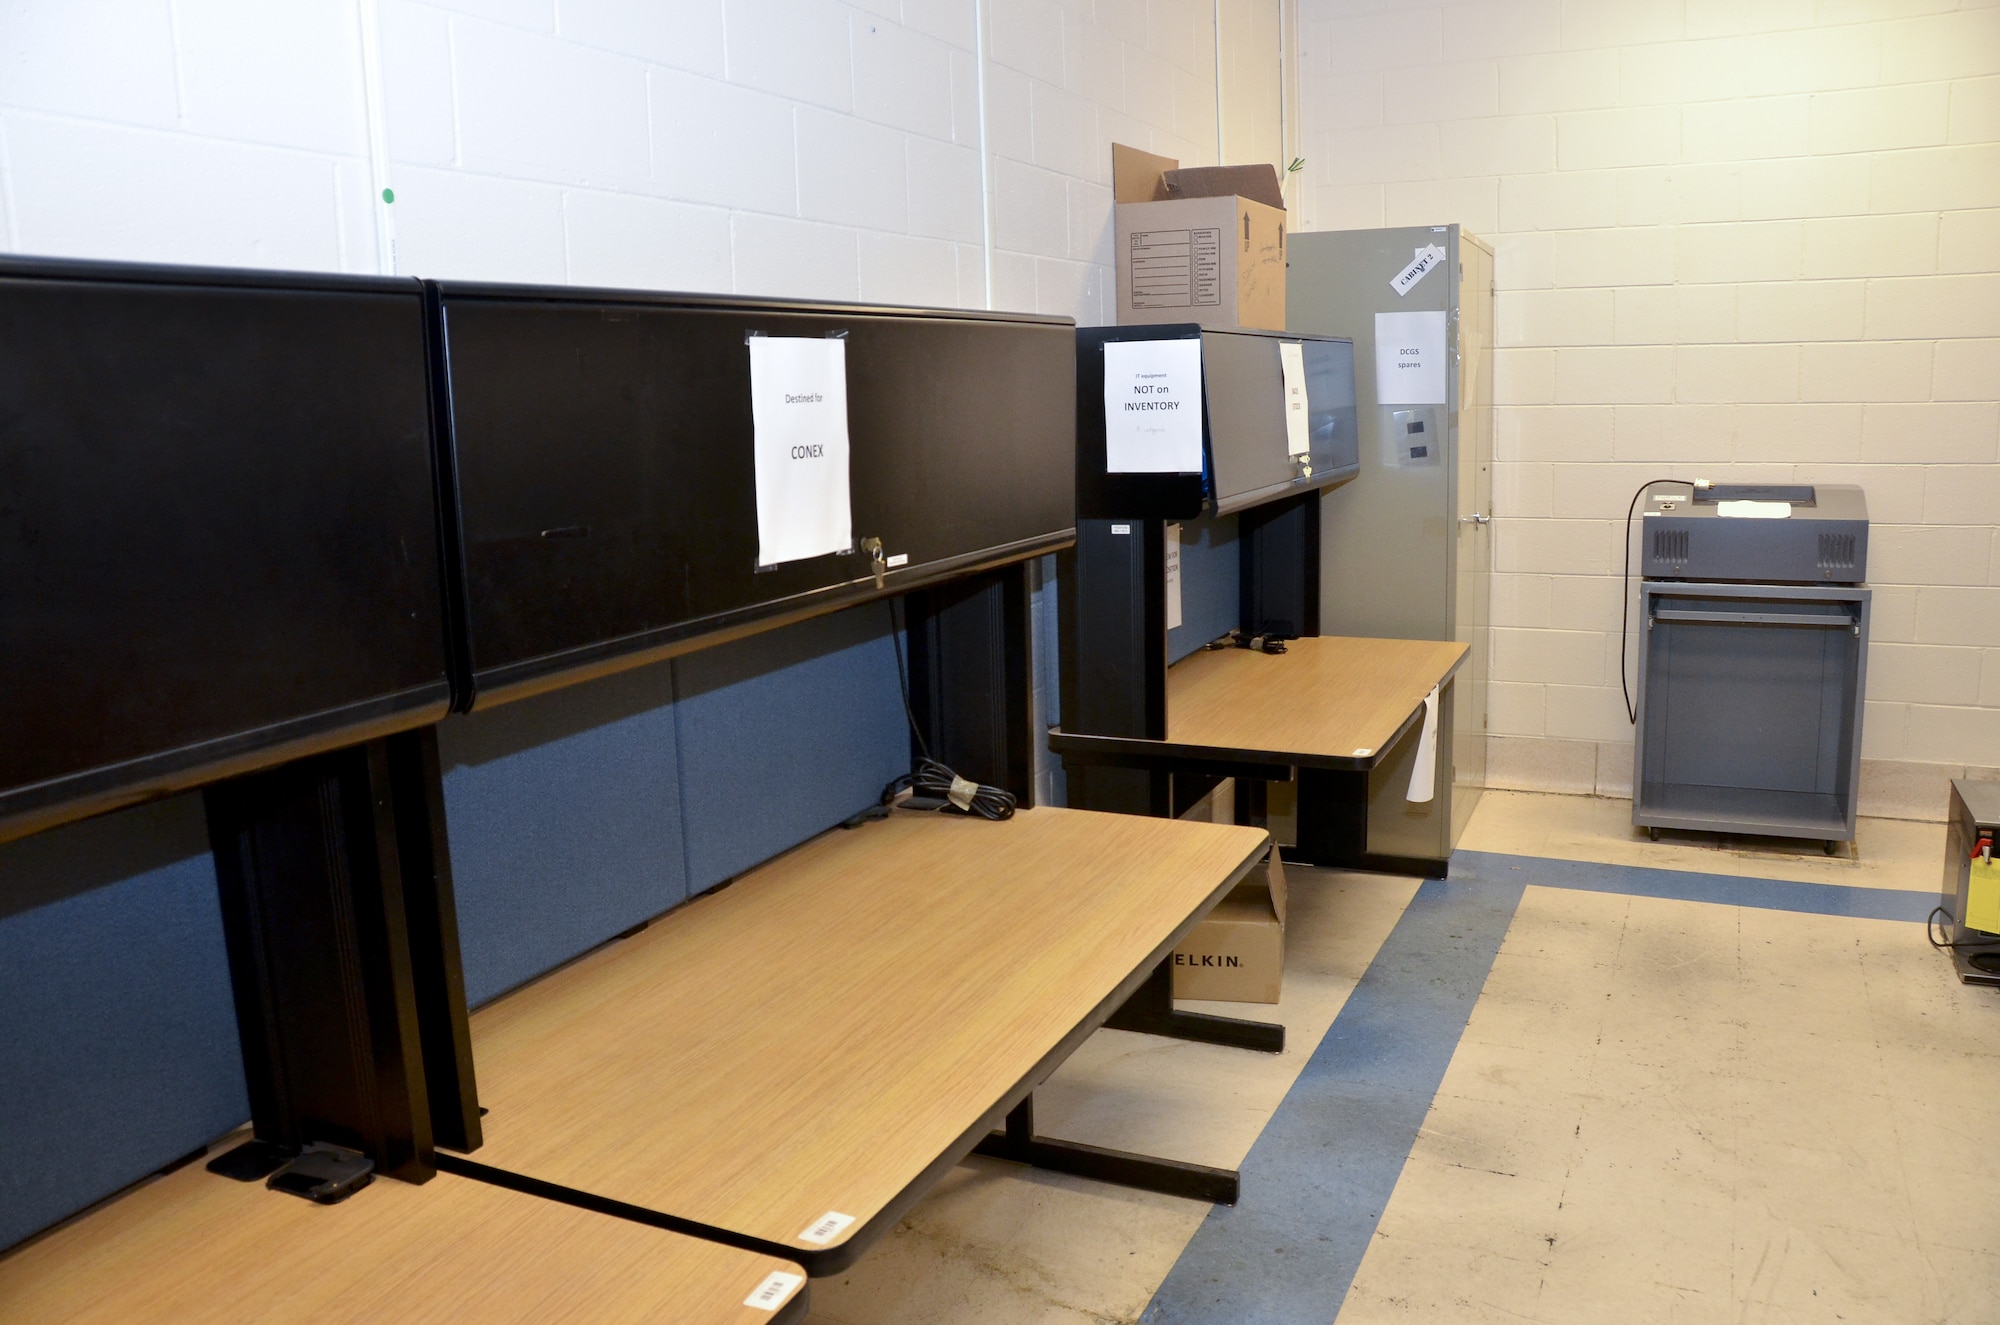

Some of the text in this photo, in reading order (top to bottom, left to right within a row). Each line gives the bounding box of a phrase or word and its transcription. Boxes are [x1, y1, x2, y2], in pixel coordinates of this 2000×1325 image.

[1400, 257, 1429, 286] CABINET
[1398, 362, 1421, 370] spares
[1134, 385, 1169, 394] NOT on
[785, 393, 823, 404] Destined for
[1124, 401, 1180, 411] INVENTORY
[791, 444, 824, 460] CONEX
[1175, 954, 1239, 967] ELKIN
